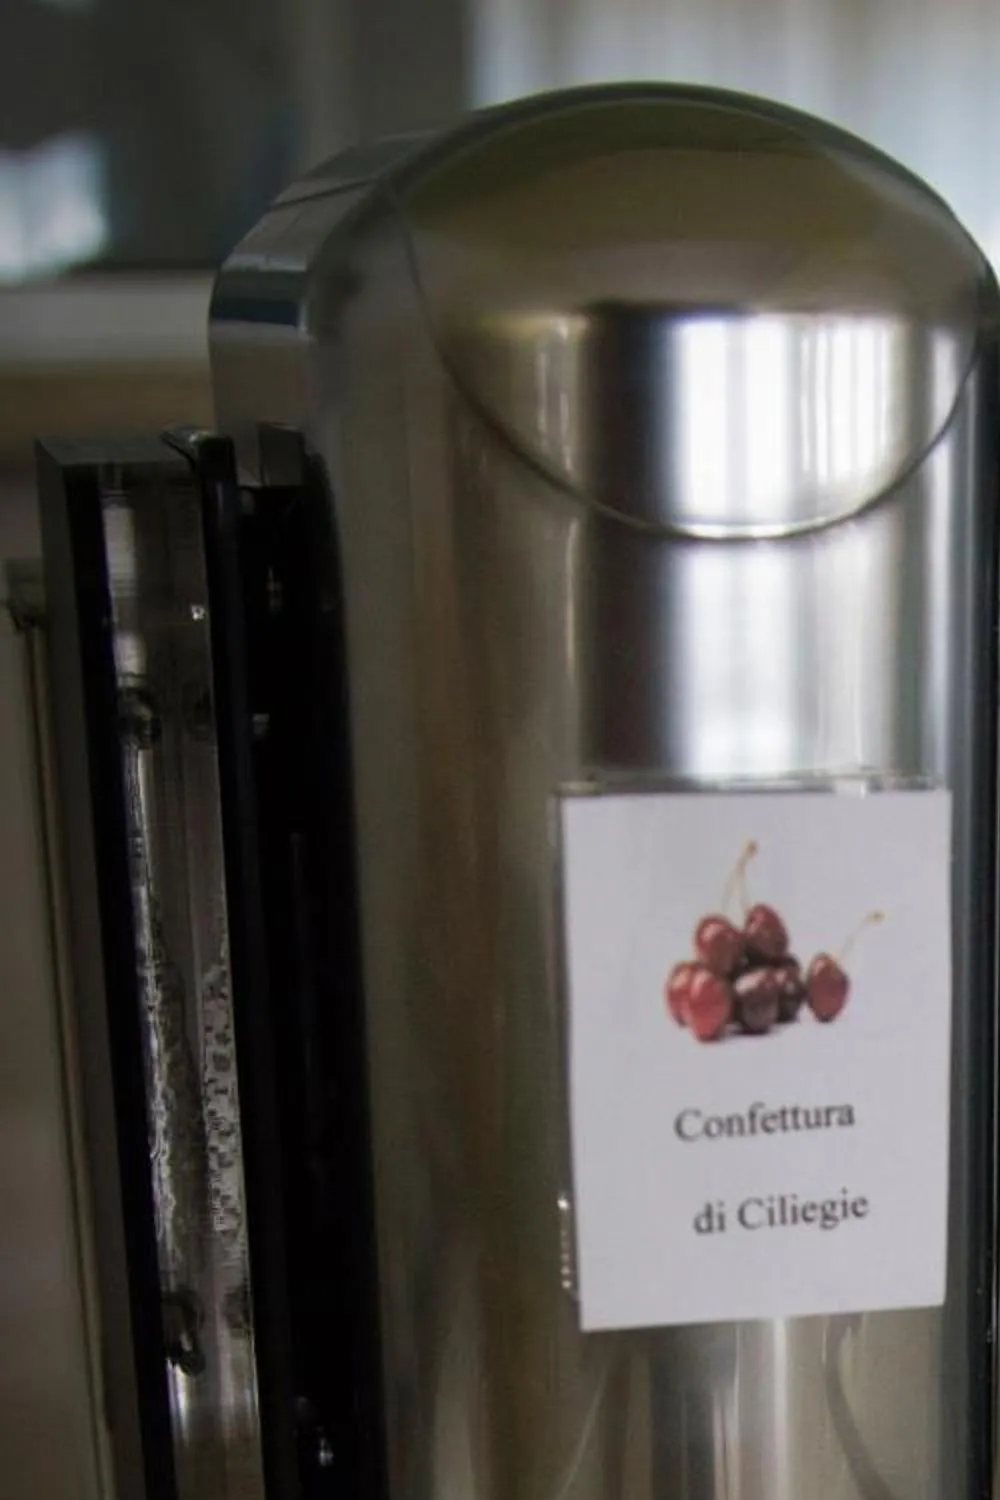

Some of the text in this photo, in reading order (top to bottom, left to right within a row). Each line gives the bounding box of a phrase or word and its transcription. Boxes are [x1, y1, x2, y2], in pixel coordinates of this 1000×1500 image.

[673, 1101, 856, 1142] Confettura
[692, 1187, 869, 1235] di Ciliegie
